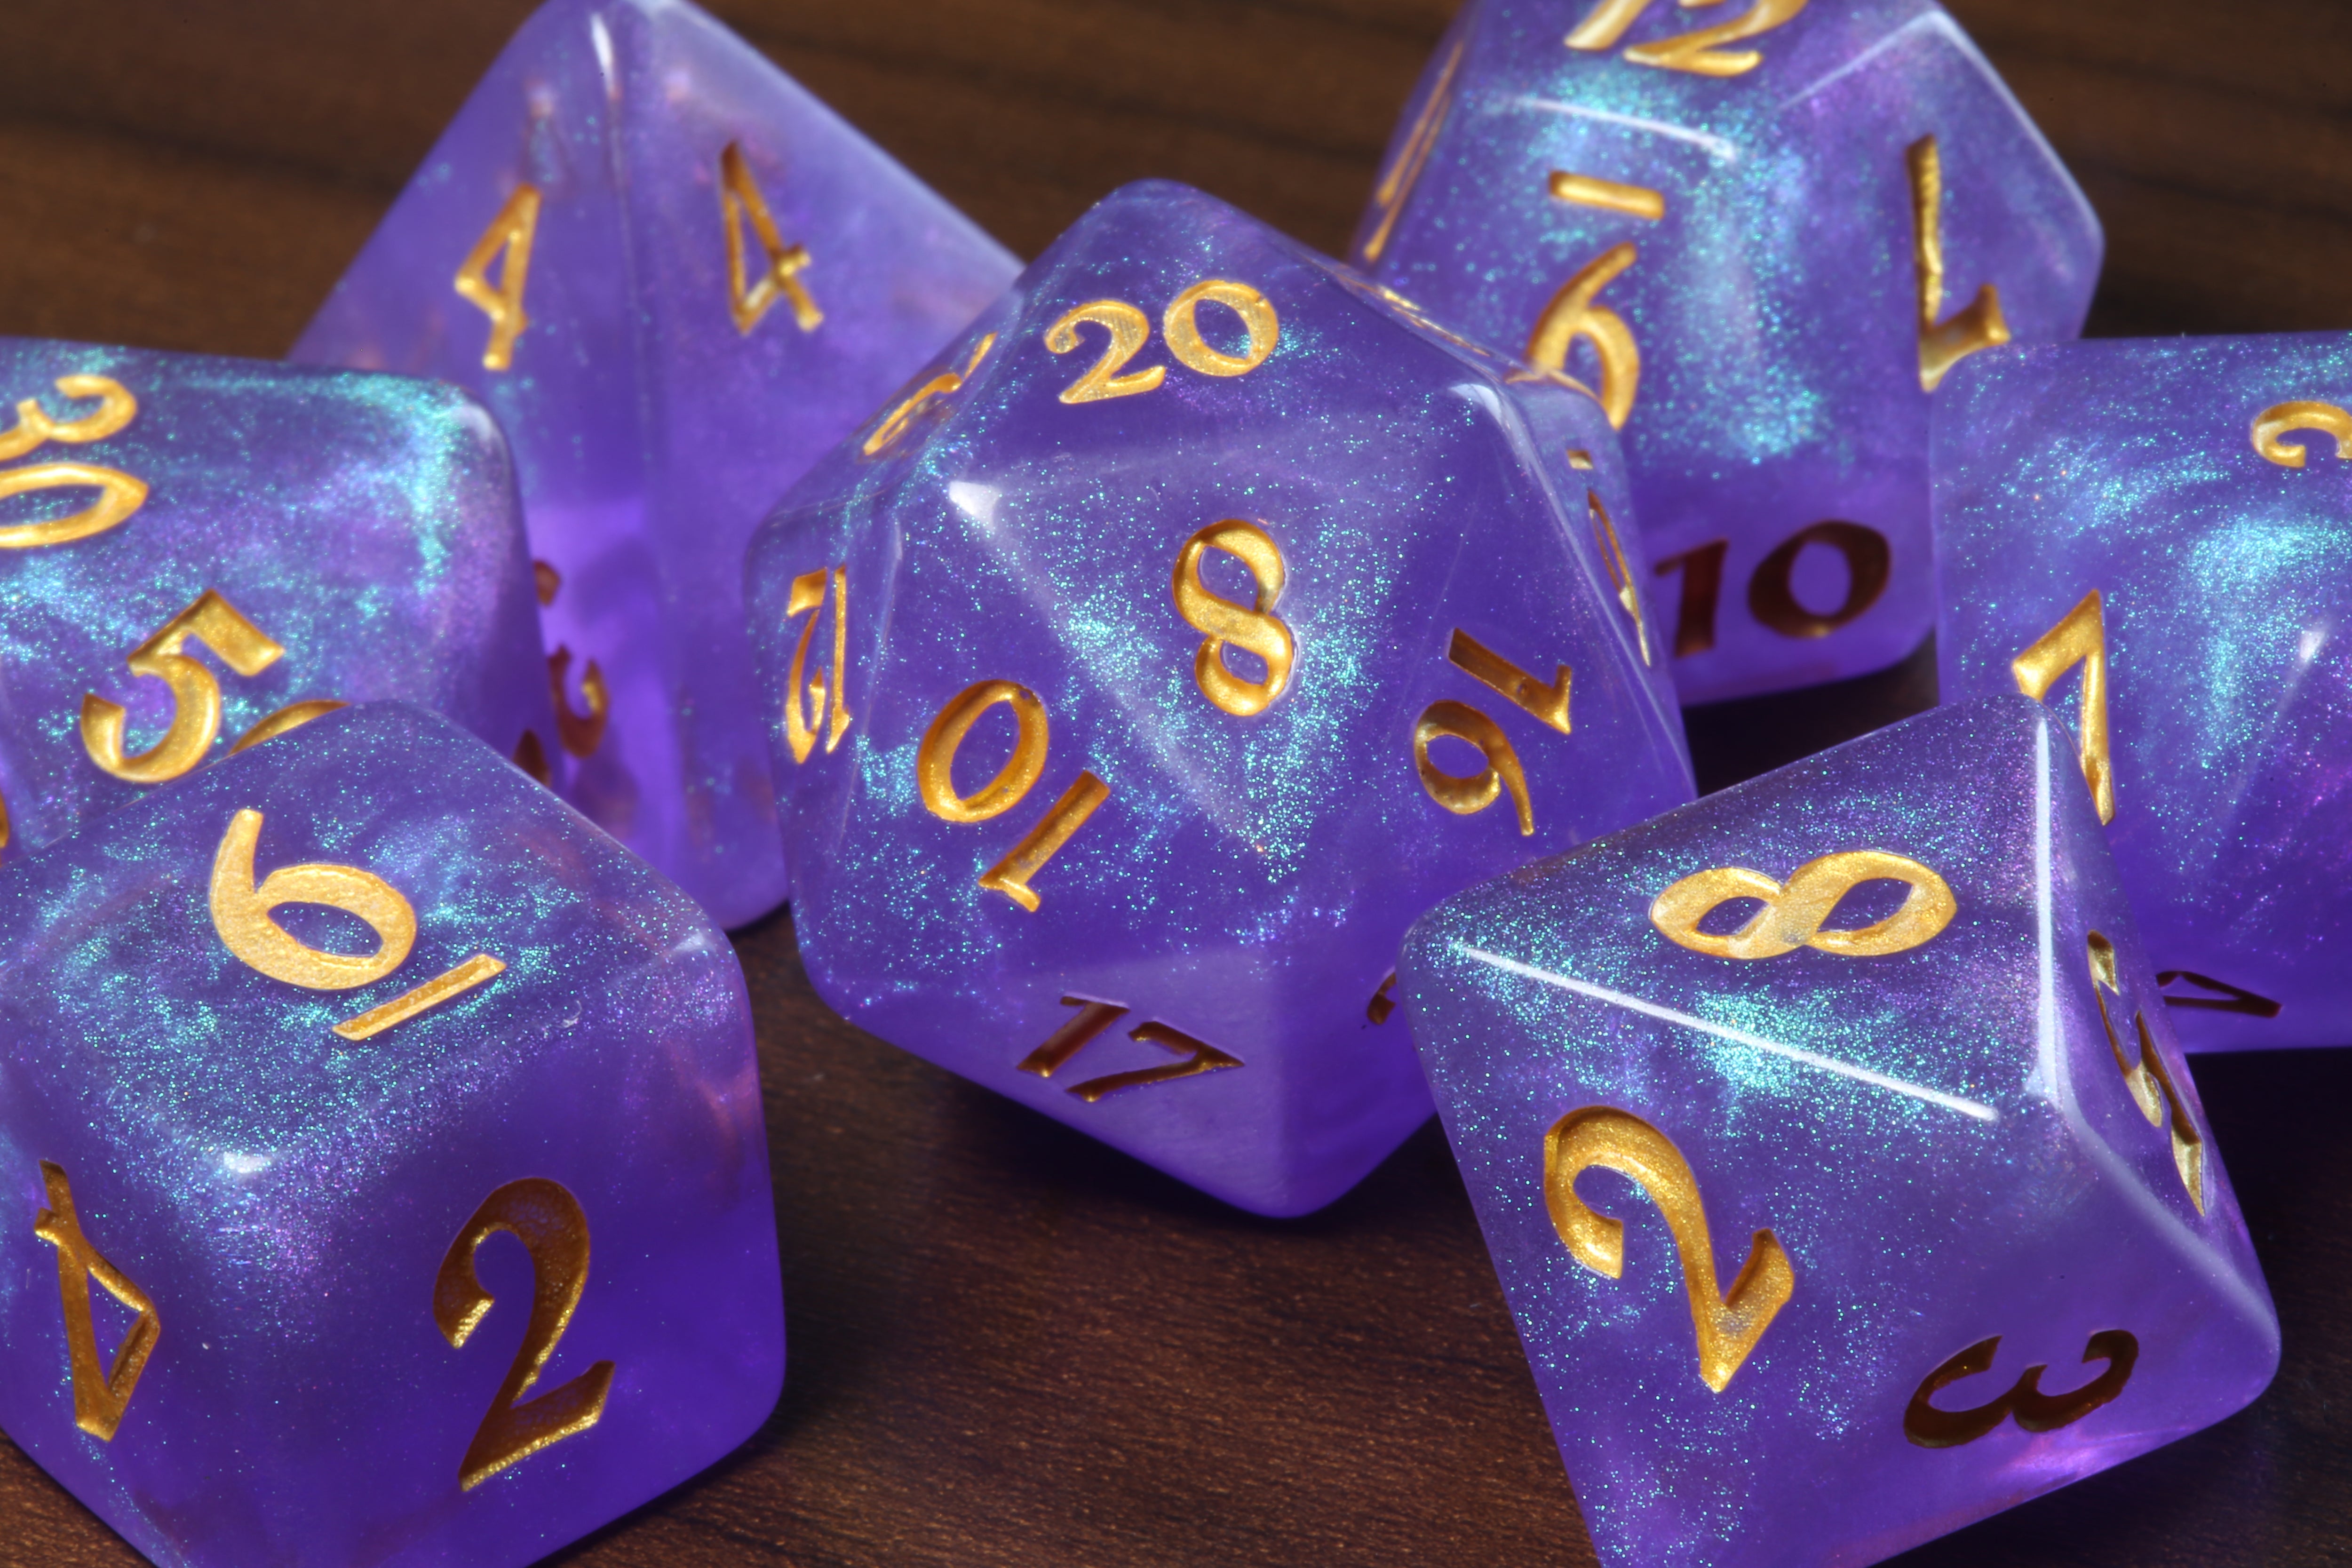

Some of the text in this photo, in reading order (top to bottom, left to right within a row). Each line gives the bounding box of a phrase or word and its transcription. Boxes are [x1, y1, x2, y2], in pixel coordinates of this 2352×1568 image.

[454, 182, 543, 372] 4
[721, 139, 824, 337] 4
[1906, 133, 2010, 393] 7
[1043, 279, 1279, 405] 20
[1171, 518, 1293, 716] 8
[1653, 517, 1892, 658] 10
[917, 679, 1111, 913] 10
[1414, 627, 1573, 836] 16
[2011, 588, 2115, 826] 7
[1651, 850, 1958, 960] 8
[1016, 993, 1245, 1102] 17
[34, 1159, 161, 1442] 4
[433, 1177, 616, 1492] 2
[1544, 1106, 1795, 1393] 2
[1903, 1329, 2139, 1450] 3
